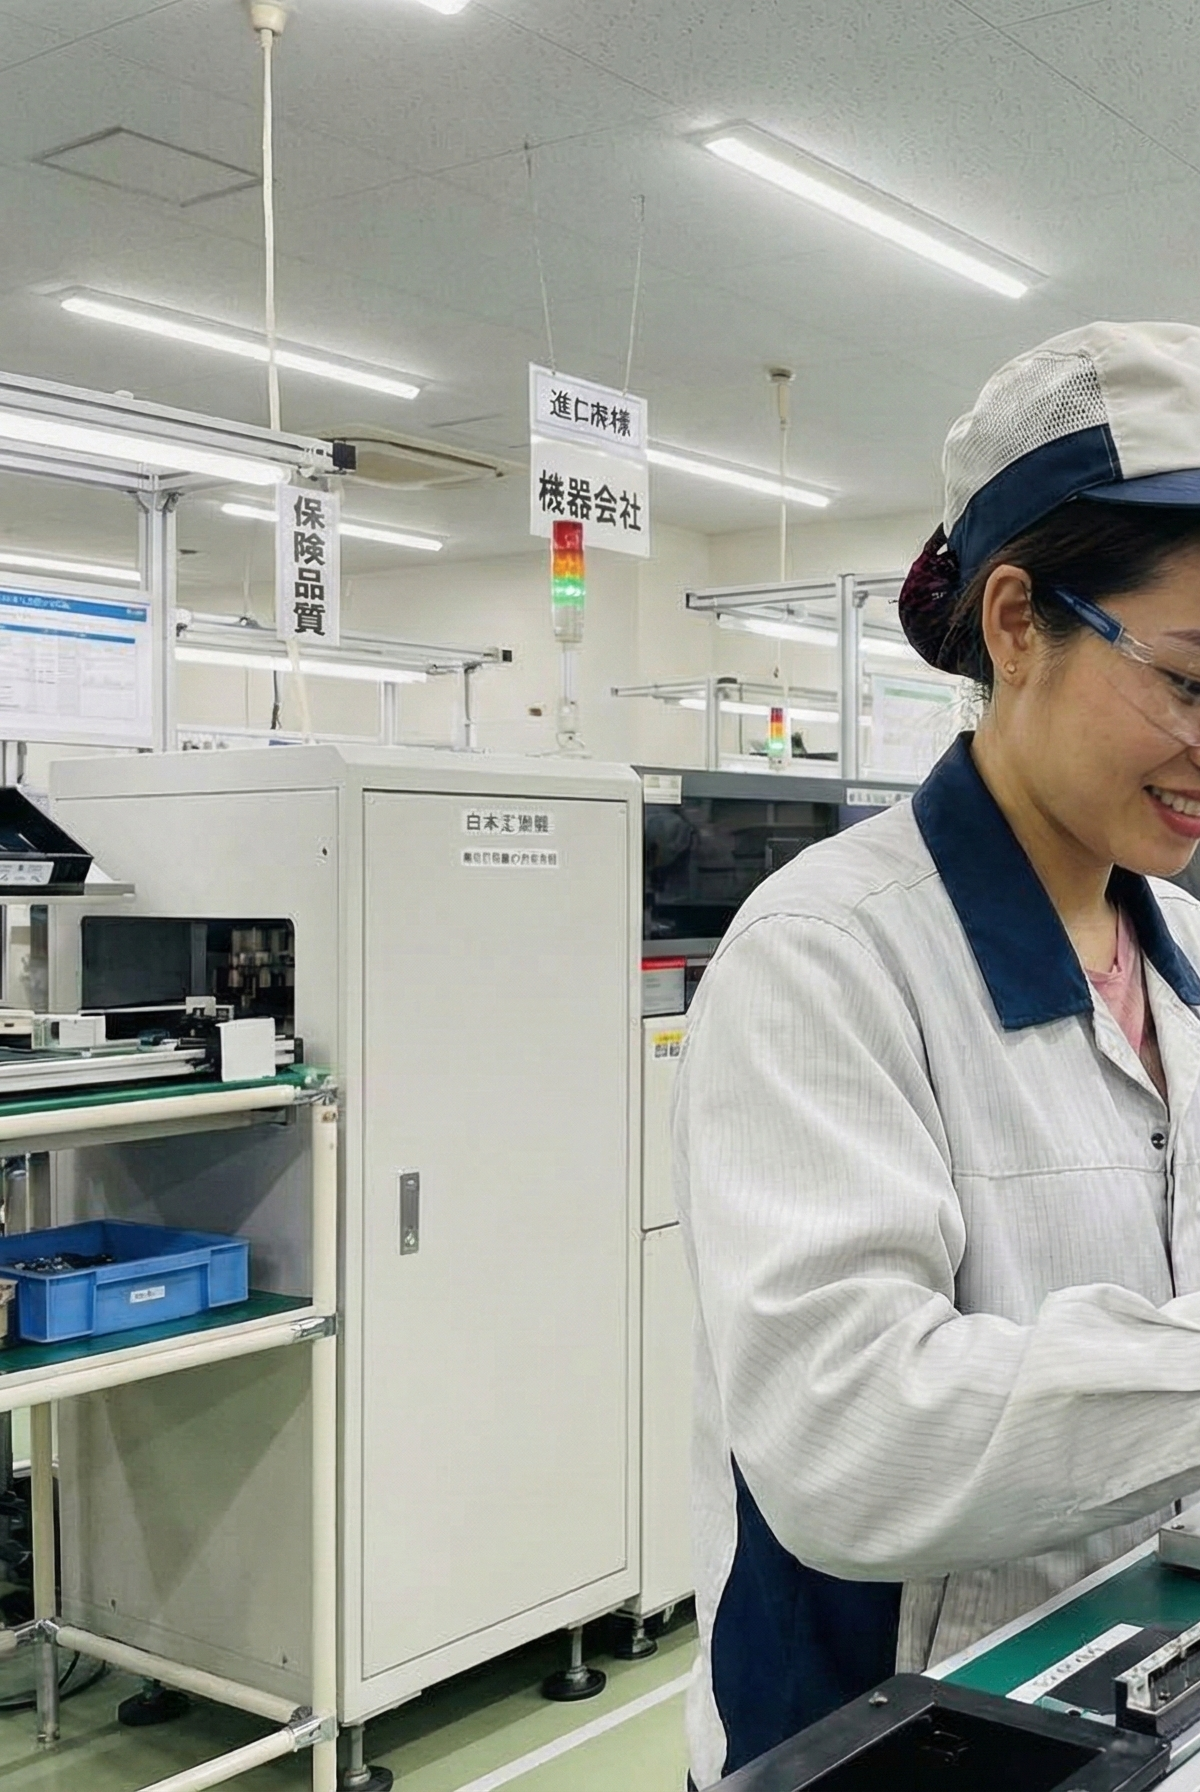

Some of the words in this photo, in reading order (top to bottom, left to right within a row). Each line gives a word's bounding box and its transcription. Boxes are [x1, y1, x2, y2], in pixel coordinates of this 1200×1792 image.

[539, 469, 641, 531] 機器会社
[293, 495, 326, 637] 保険品質
